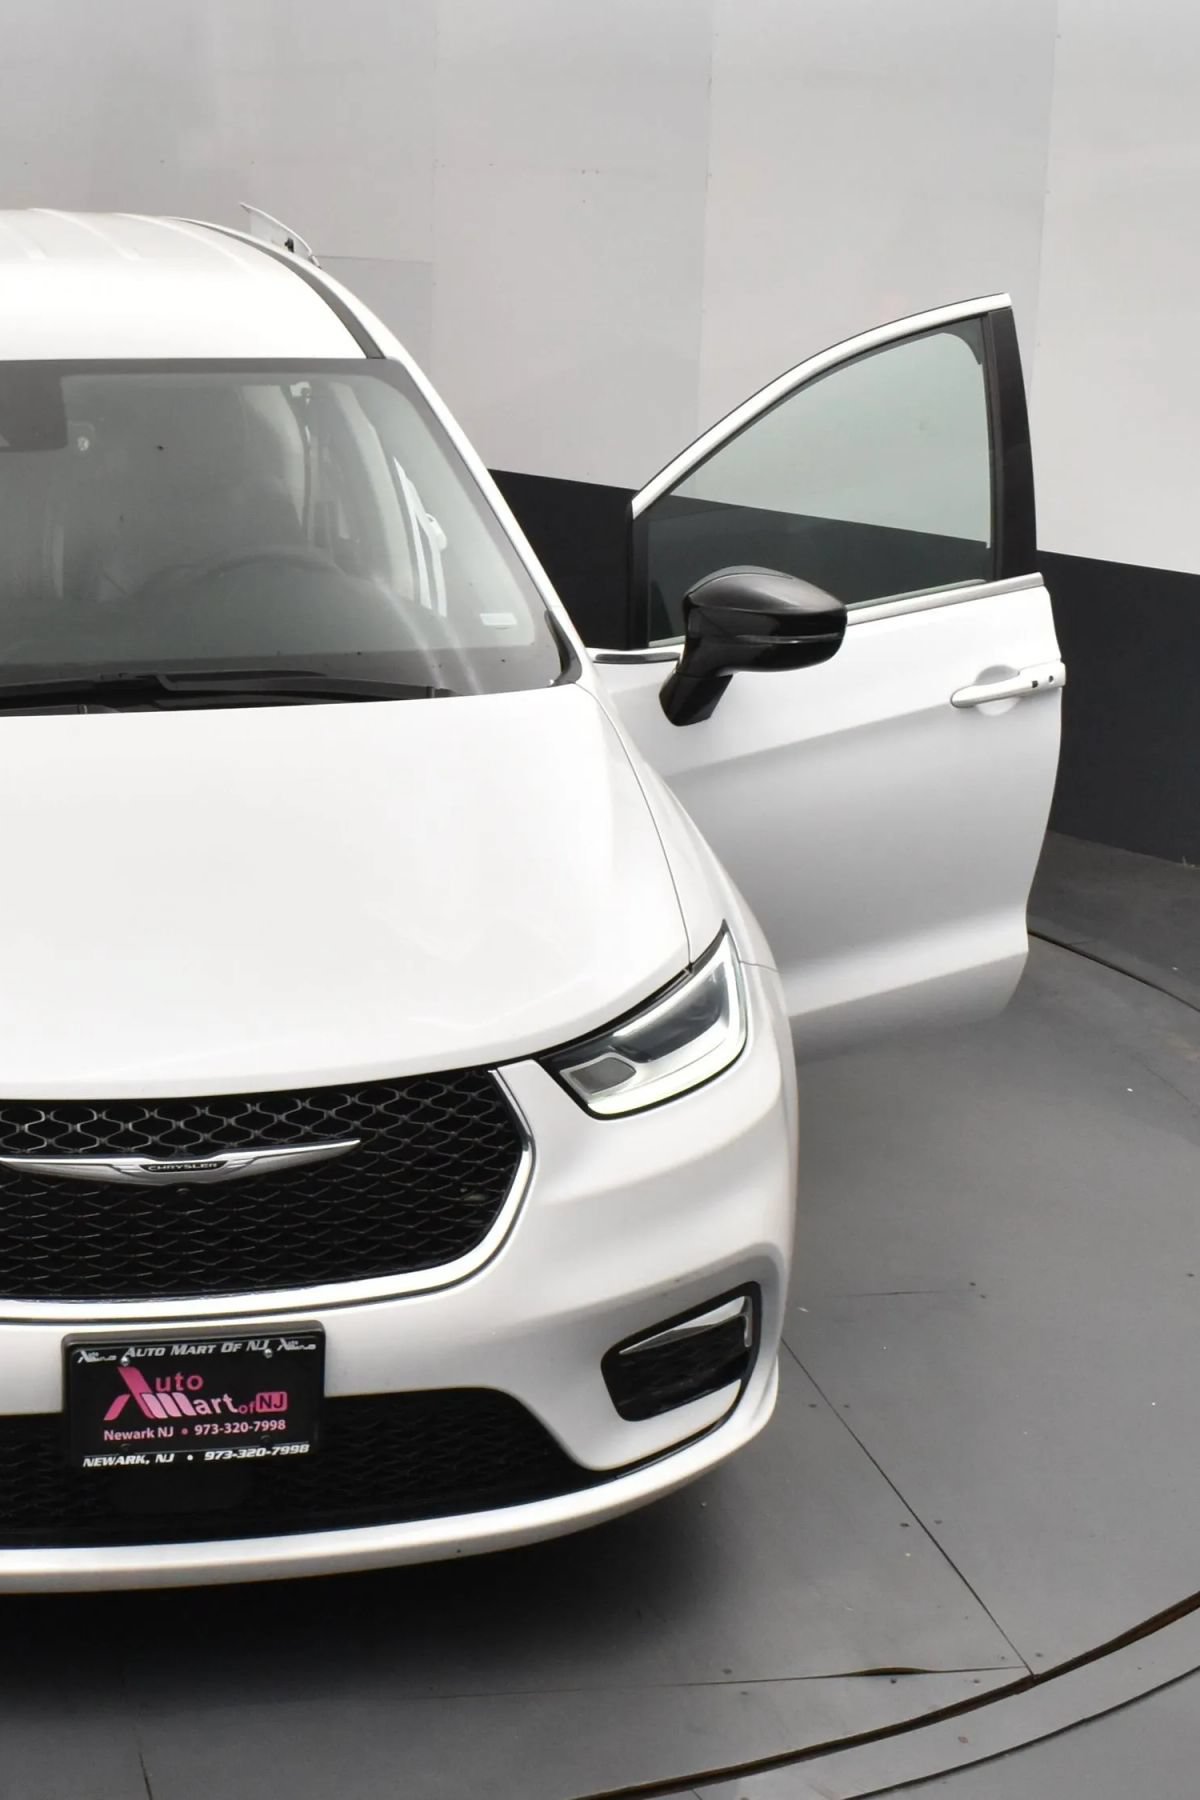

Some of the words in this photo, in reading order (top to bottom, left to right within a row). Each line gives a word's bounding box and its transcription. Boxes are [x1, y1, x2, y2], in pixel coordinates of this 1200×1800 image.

[148, 1162, 217, 1171] CHRYSLER
[246, 1340, 270, 1351] NJ
[238, 1402, 256, 1415] of
[258, 1394, 286, 1410] NJ
[104, 1427, 155, 1441] Newark
[157, 1426, 174, 1438] NJ
[194, 1420, 286, 1436] 973-320-7998
[83, 1454, 150, 1467] NEWARK,
[155, 1453, 175, 1463] NJ
[204, 1445, 310, 1461] 973-320-7998
